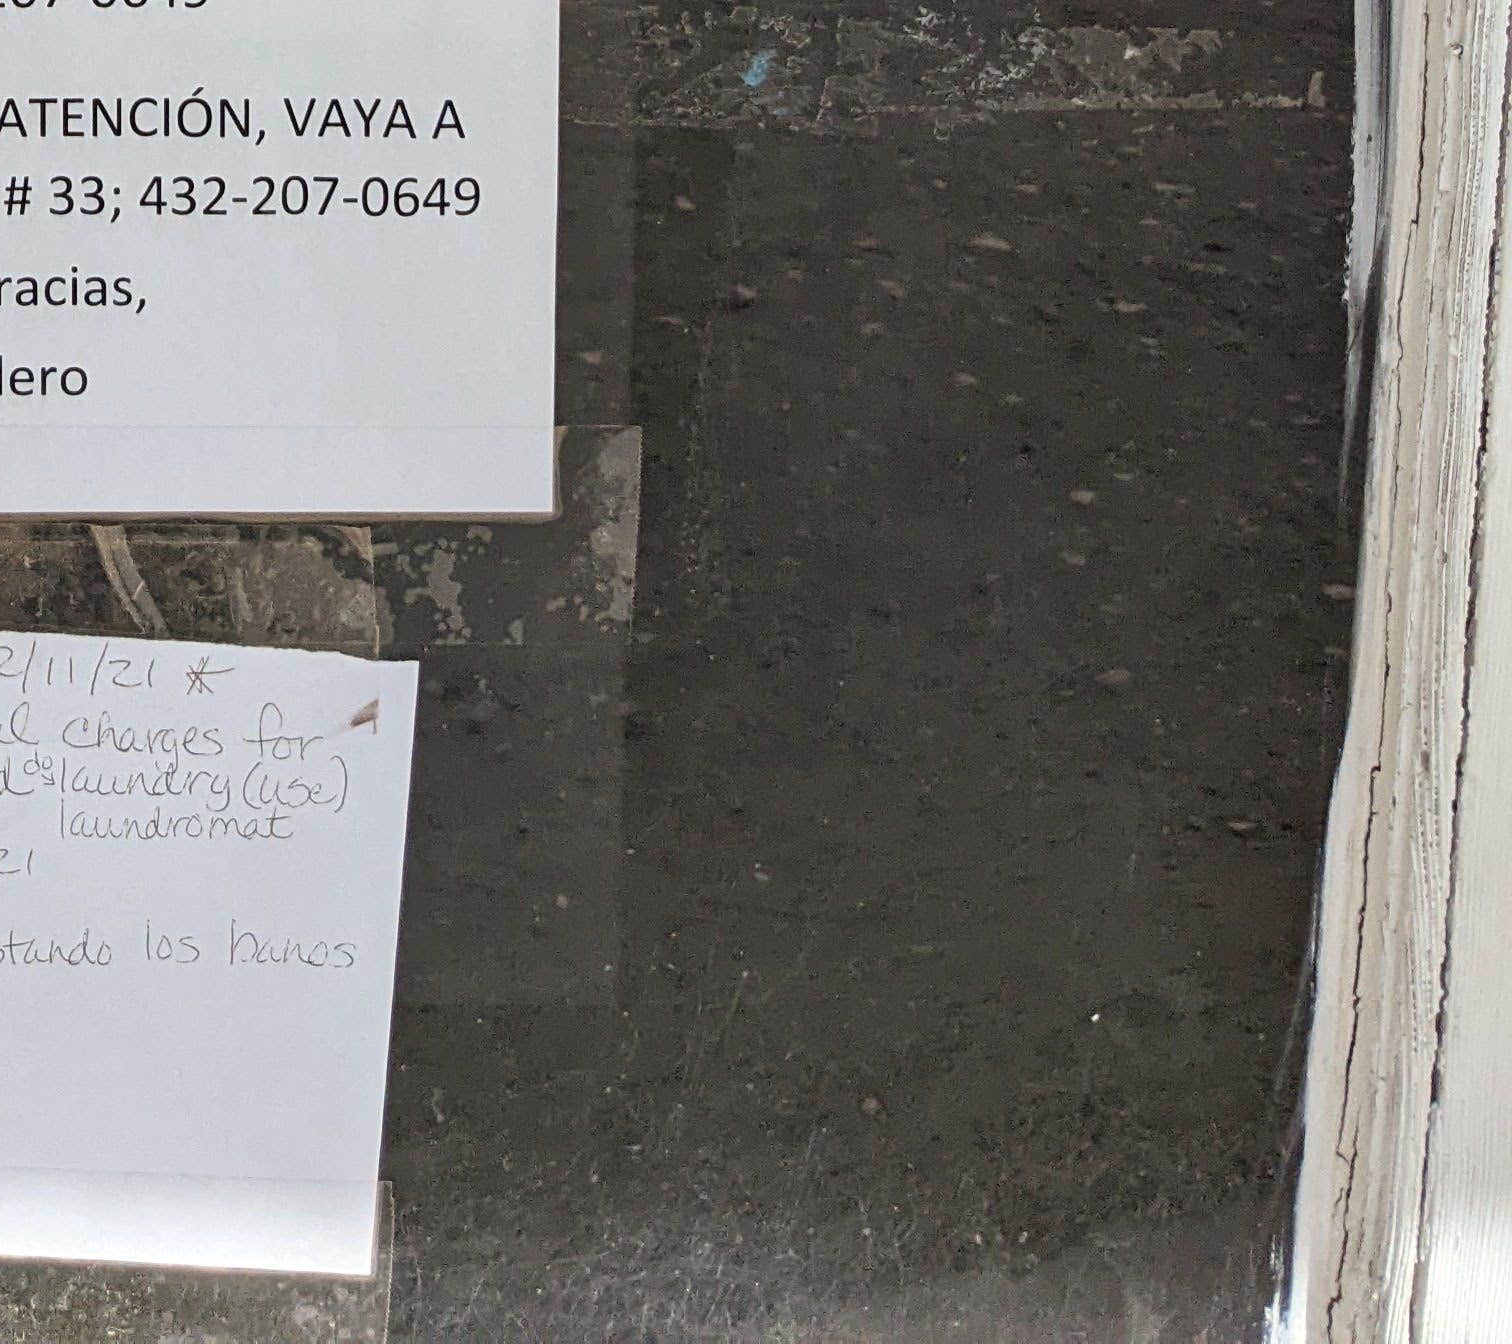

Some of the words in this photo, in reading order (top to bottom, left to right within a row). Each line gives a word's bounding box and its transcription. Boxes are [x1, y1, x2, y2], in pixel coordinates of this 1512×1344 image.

[283, 97, 417, 140] VAYA
[431, 99, 466, 140] A
[3, 175, 33, 216] #
[49, 175, 121, 225] 33;
[139, 175, 481, 218] 432-207-0649
[243, 702, 323, 762] for
[22, 751, 54, 776] do
[59, 757, 234, 810] laundry
[242, 755, 348, 813] (use)
[61, 799, 294, 840] laundromat
[146, 920, 201, 964] los
